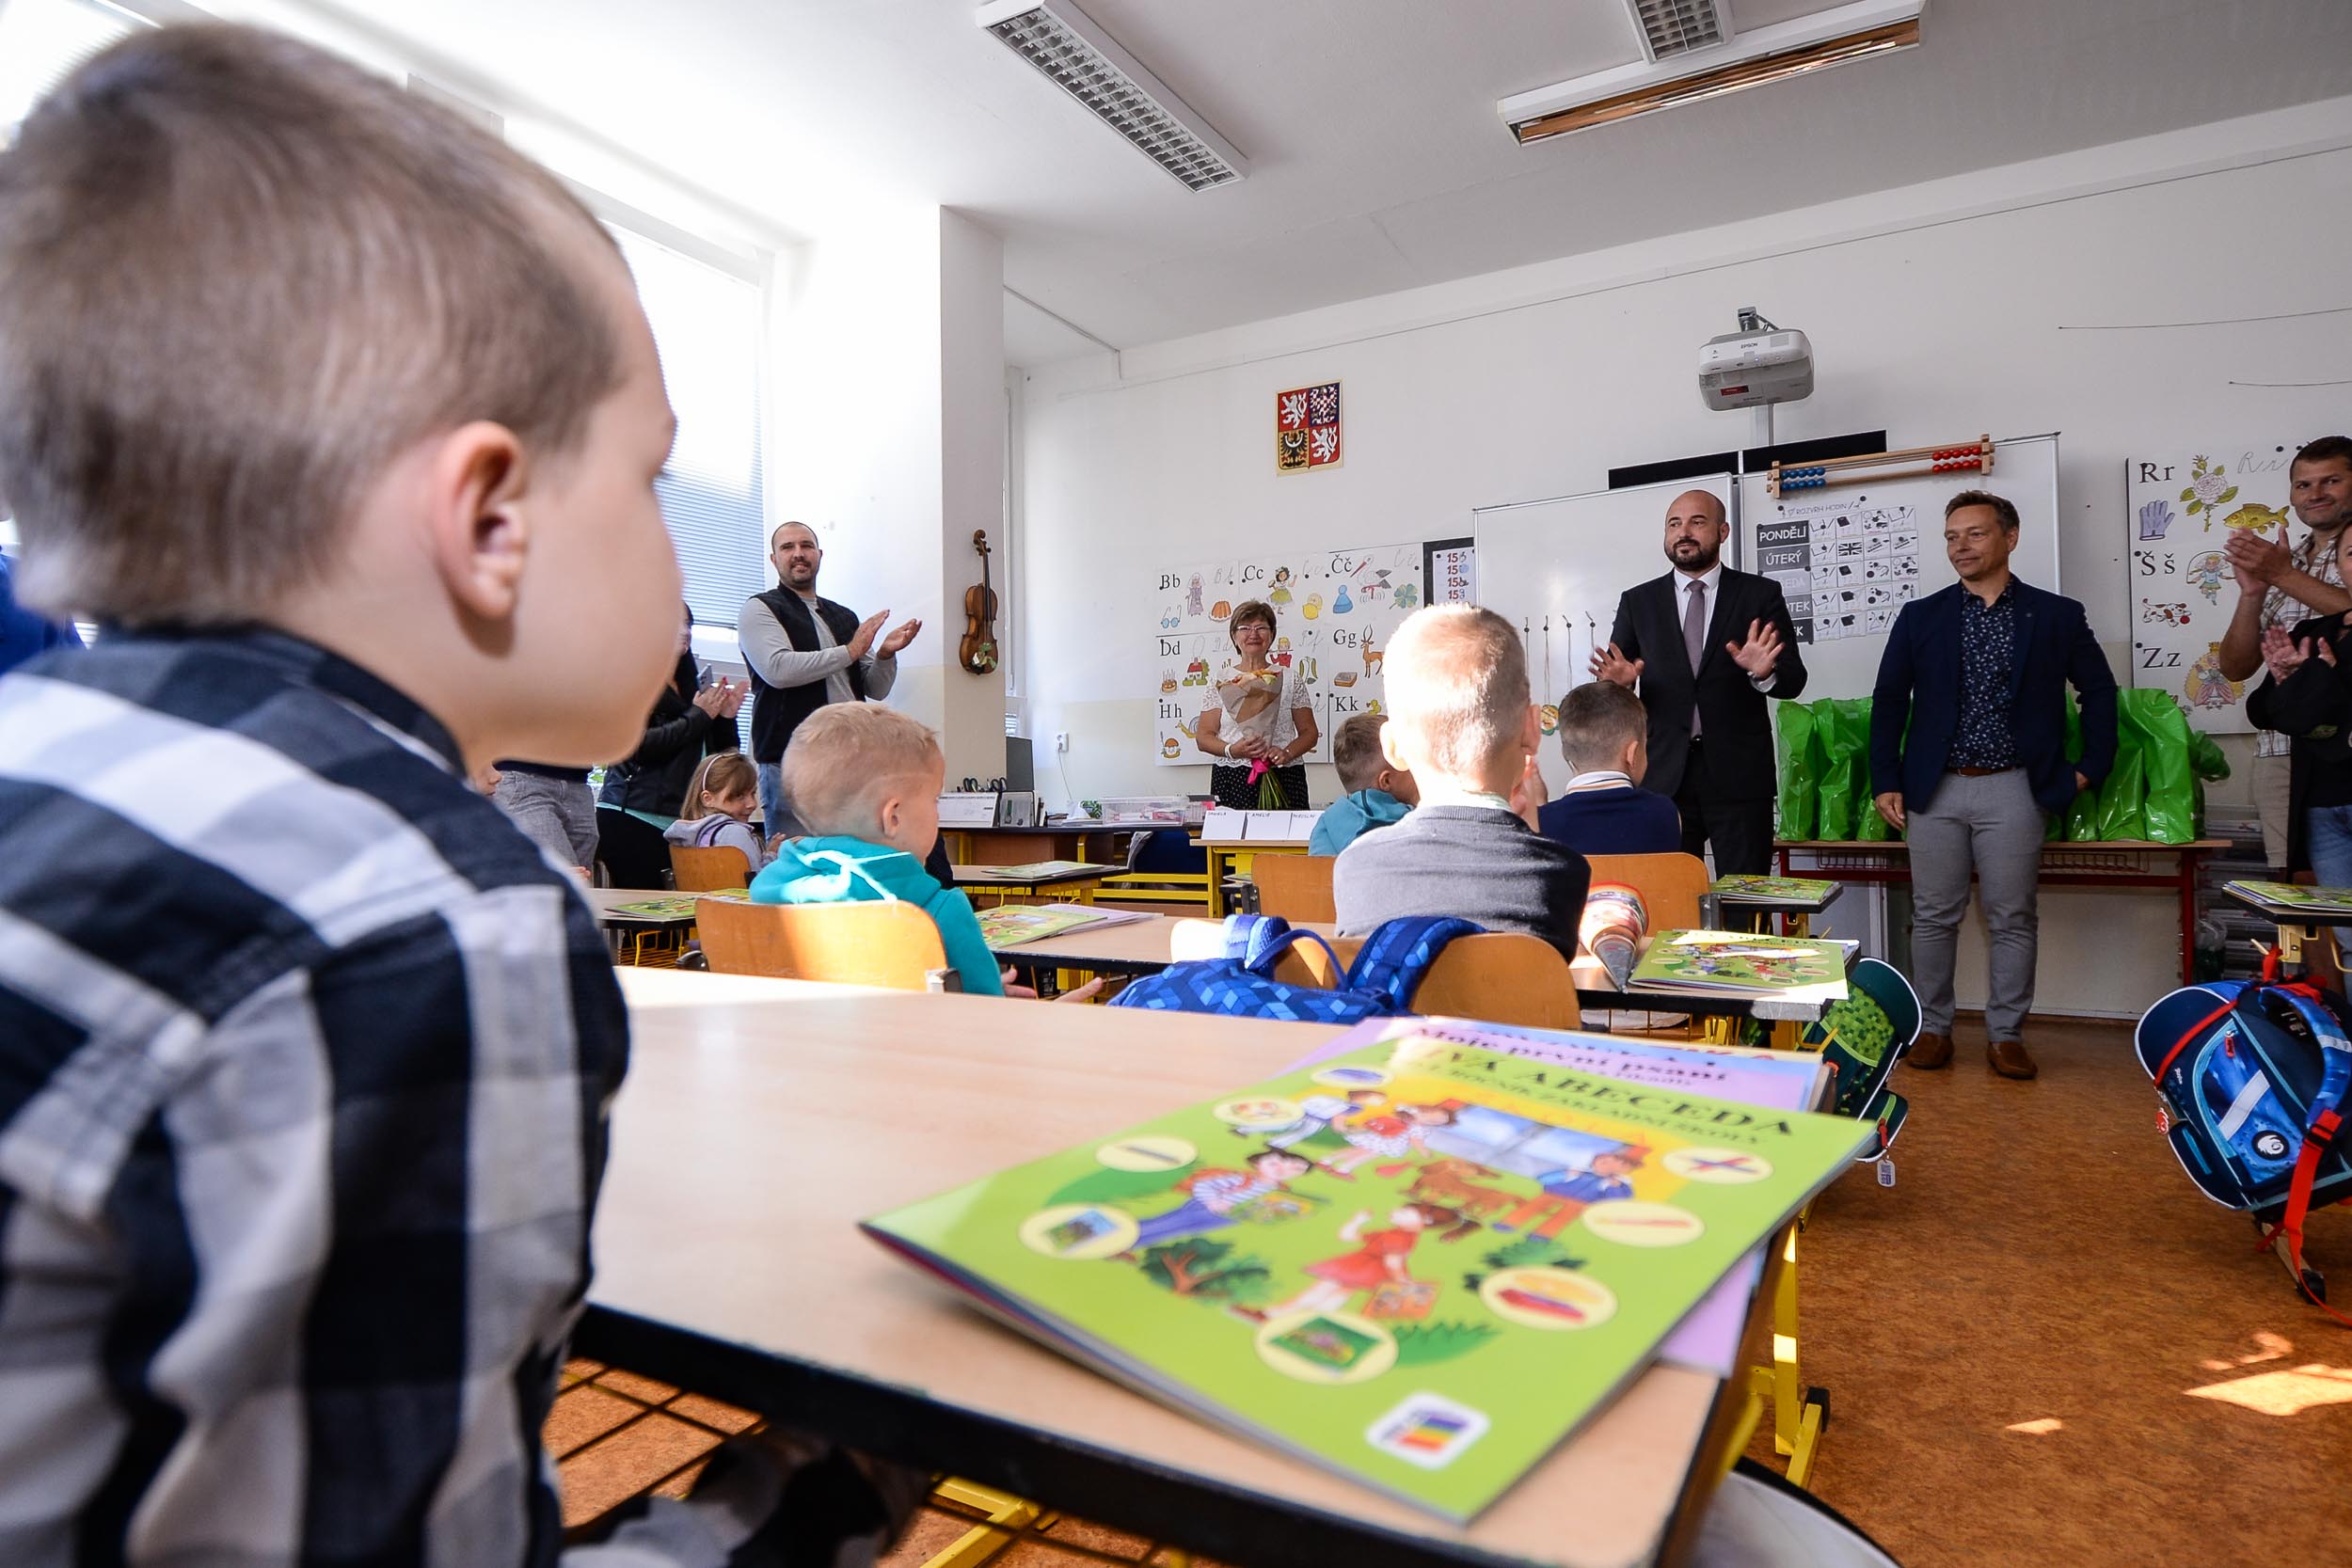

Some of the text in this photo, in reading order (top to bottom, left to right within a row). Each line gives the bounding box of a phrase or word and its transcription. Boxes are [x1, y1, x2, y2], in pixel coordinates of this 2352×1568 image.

[1759, 525, 1807, 543] PONDĚLÍ
[1765, 549, 1803, 565] ÚTERÝ
[1244, 564, 1264, 580] Cc
[1161, 573, 1181, 589] Bb
[1333, 628, 1357, 648] Gg
[1160, 640, 1181, 656] Dd
[1335, 696, 1359, 712] Kk
[1516, 1069, 1793, 1136] ABECEDA
